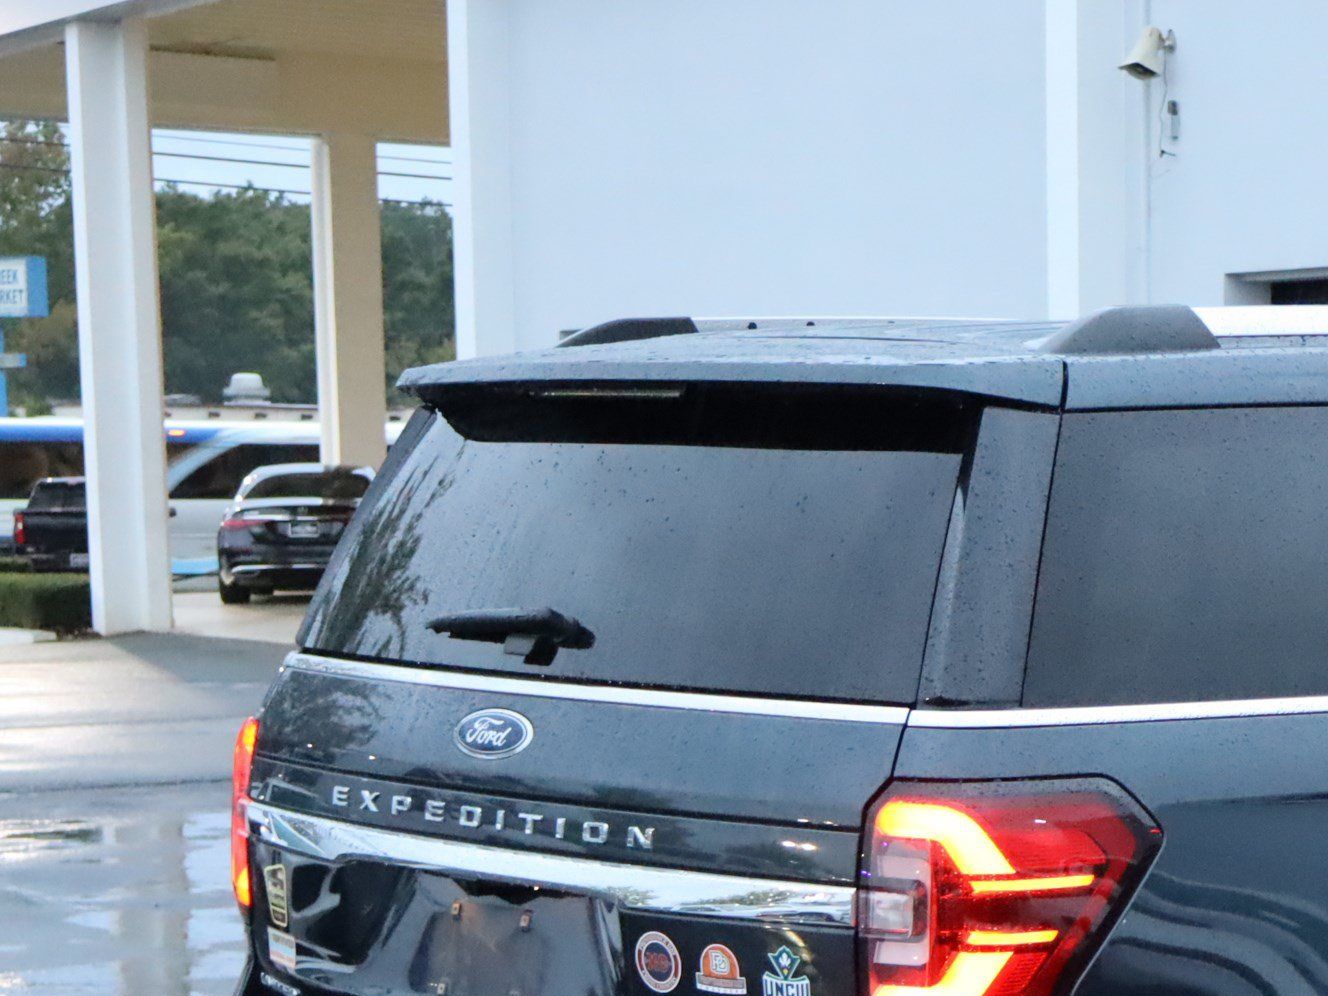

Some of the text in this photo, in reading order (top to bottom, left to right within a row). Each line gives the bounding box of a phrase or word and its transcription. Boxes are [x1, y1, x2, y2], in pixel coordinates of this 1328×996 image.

[0, 269, 18, 285] EEK
[465, 716, 513, 747] Ford
[332, 785, 656, 850] EXPEDITION
